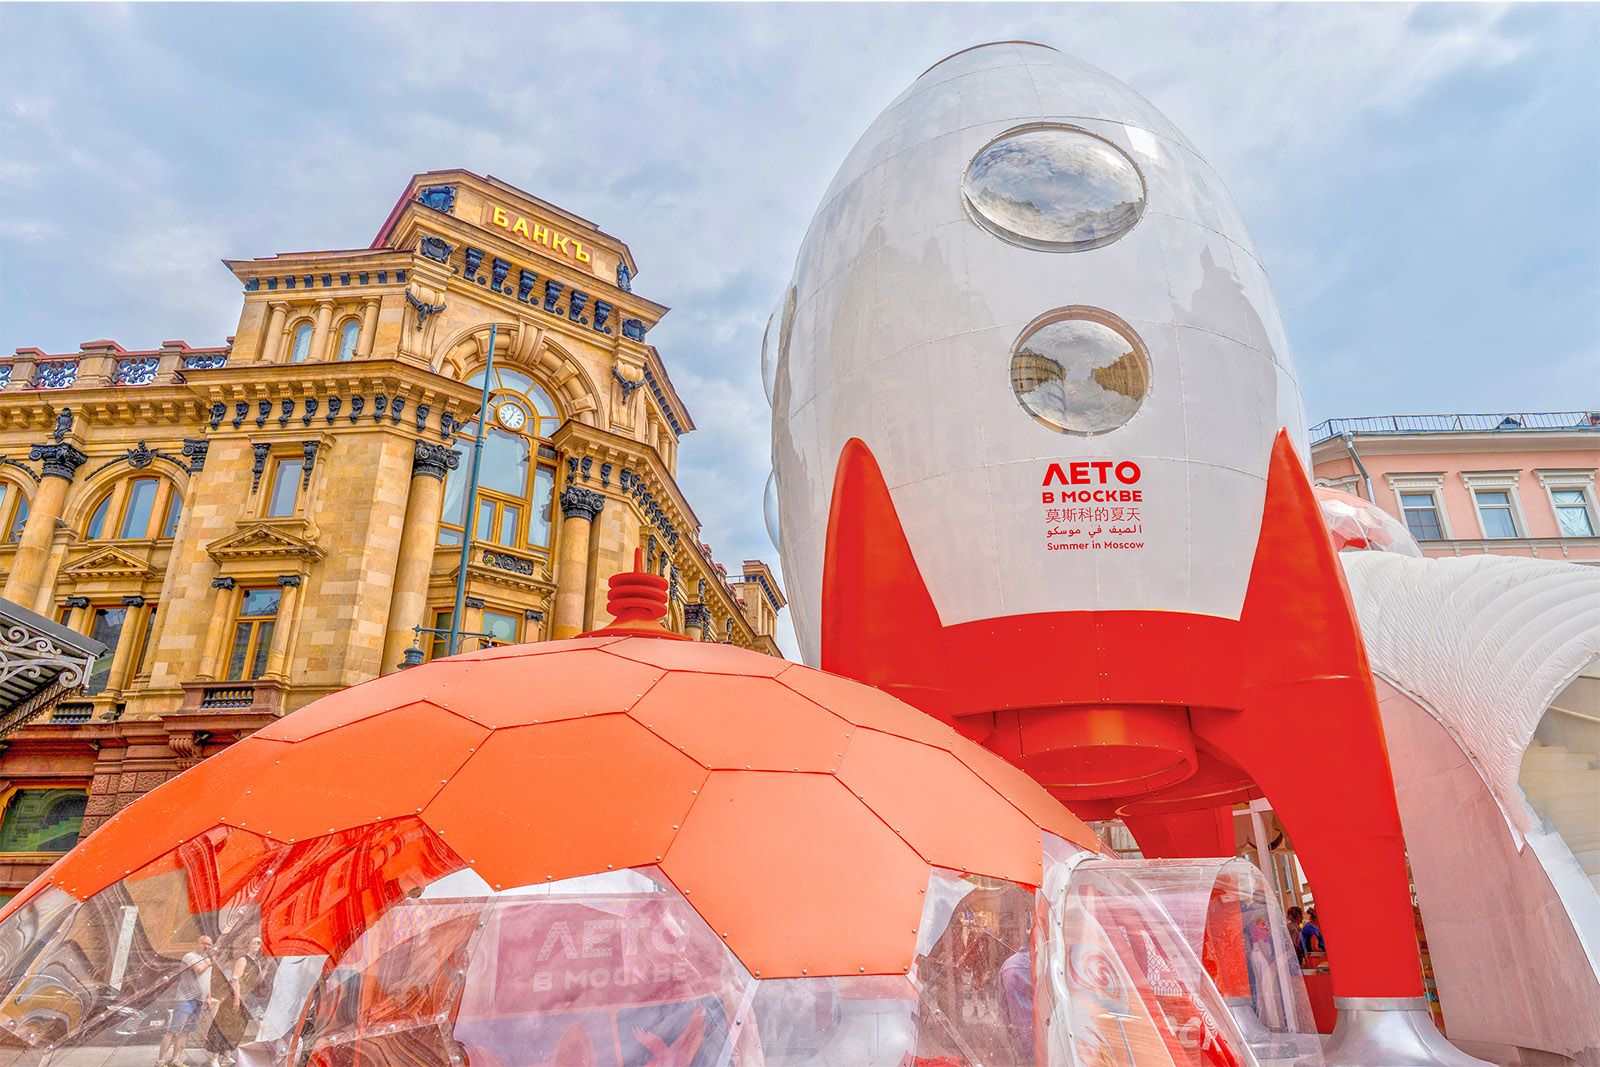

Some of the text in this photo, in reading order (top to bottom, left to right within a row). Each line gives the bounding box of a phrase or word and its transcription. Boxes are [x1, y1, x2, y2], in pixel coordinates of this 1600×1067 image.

[492, 206, 591, 264] БАНКЪ
[1042, 461, 1141, 486] ЛЕТО
[1042, 489, 1143, 504] В МОСКВЕ
[1045, 507, 1141, 523] 莫斯科的夏天
[1046, 524, 1142, 538] الصيف في موسكو
[1047, 540, 1144, 550] Summer in Moscow
[532, 971, 552, 992] В
